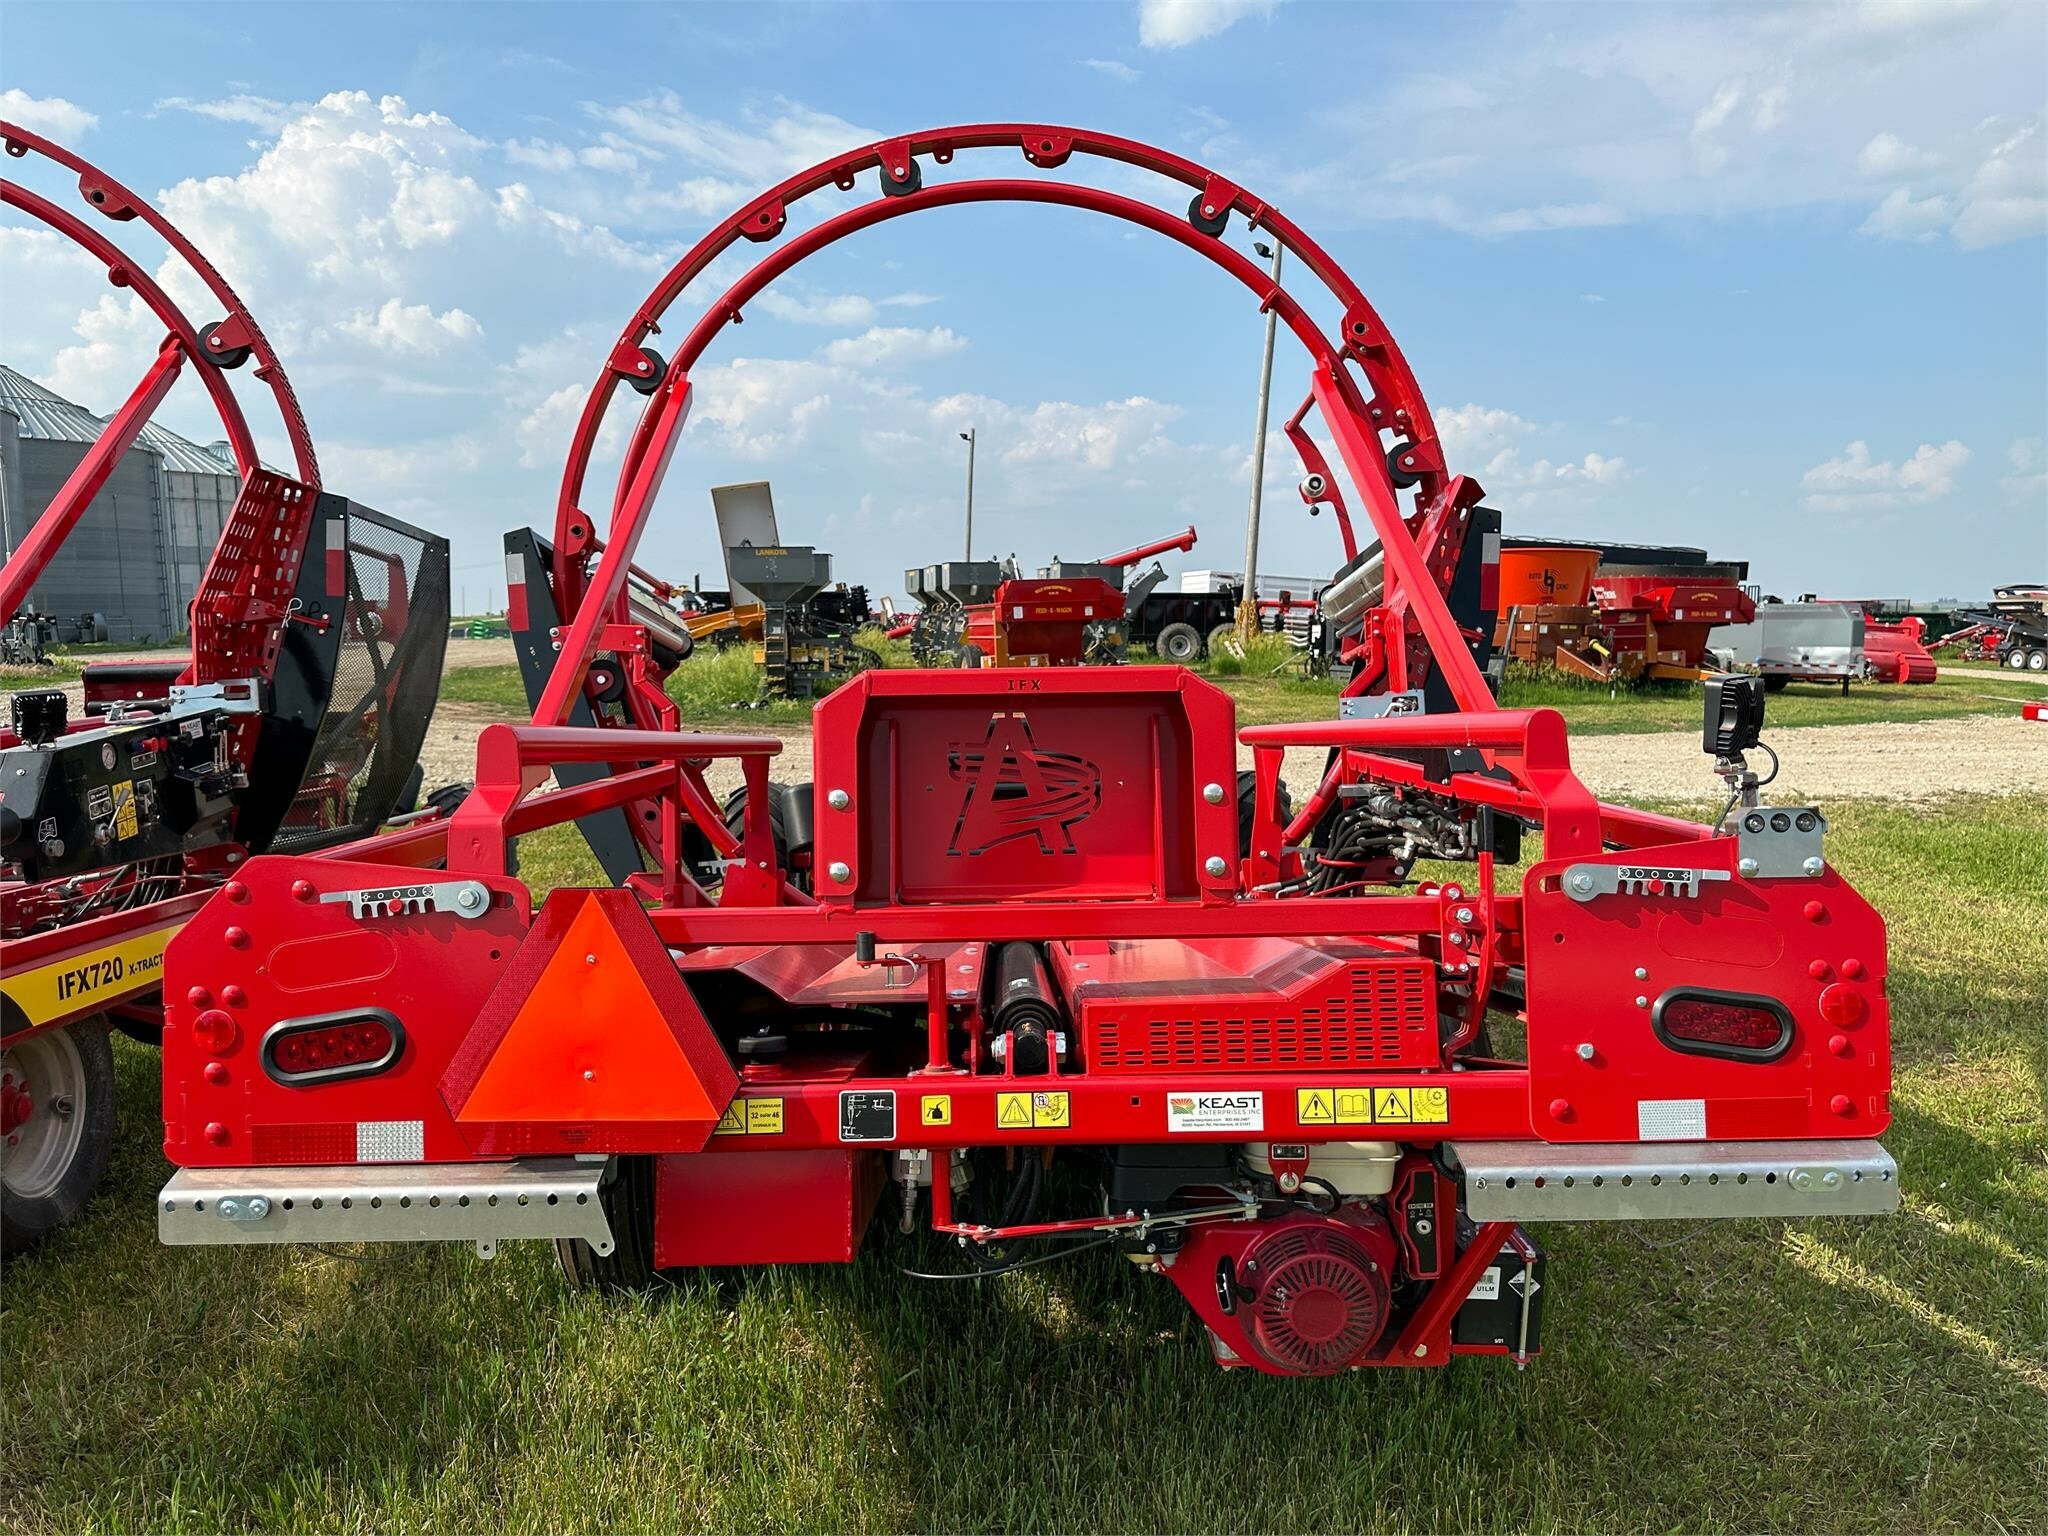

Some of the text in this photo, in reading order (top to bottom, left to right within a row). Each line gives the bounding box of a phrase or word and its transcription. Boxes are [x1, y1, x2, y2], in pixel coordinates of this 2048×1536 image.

[1008, 679, 1041, 691] IFX
[57, 956, 123, 1000] IFX720
[1199, 1097, 1260, 1109] KEAST
